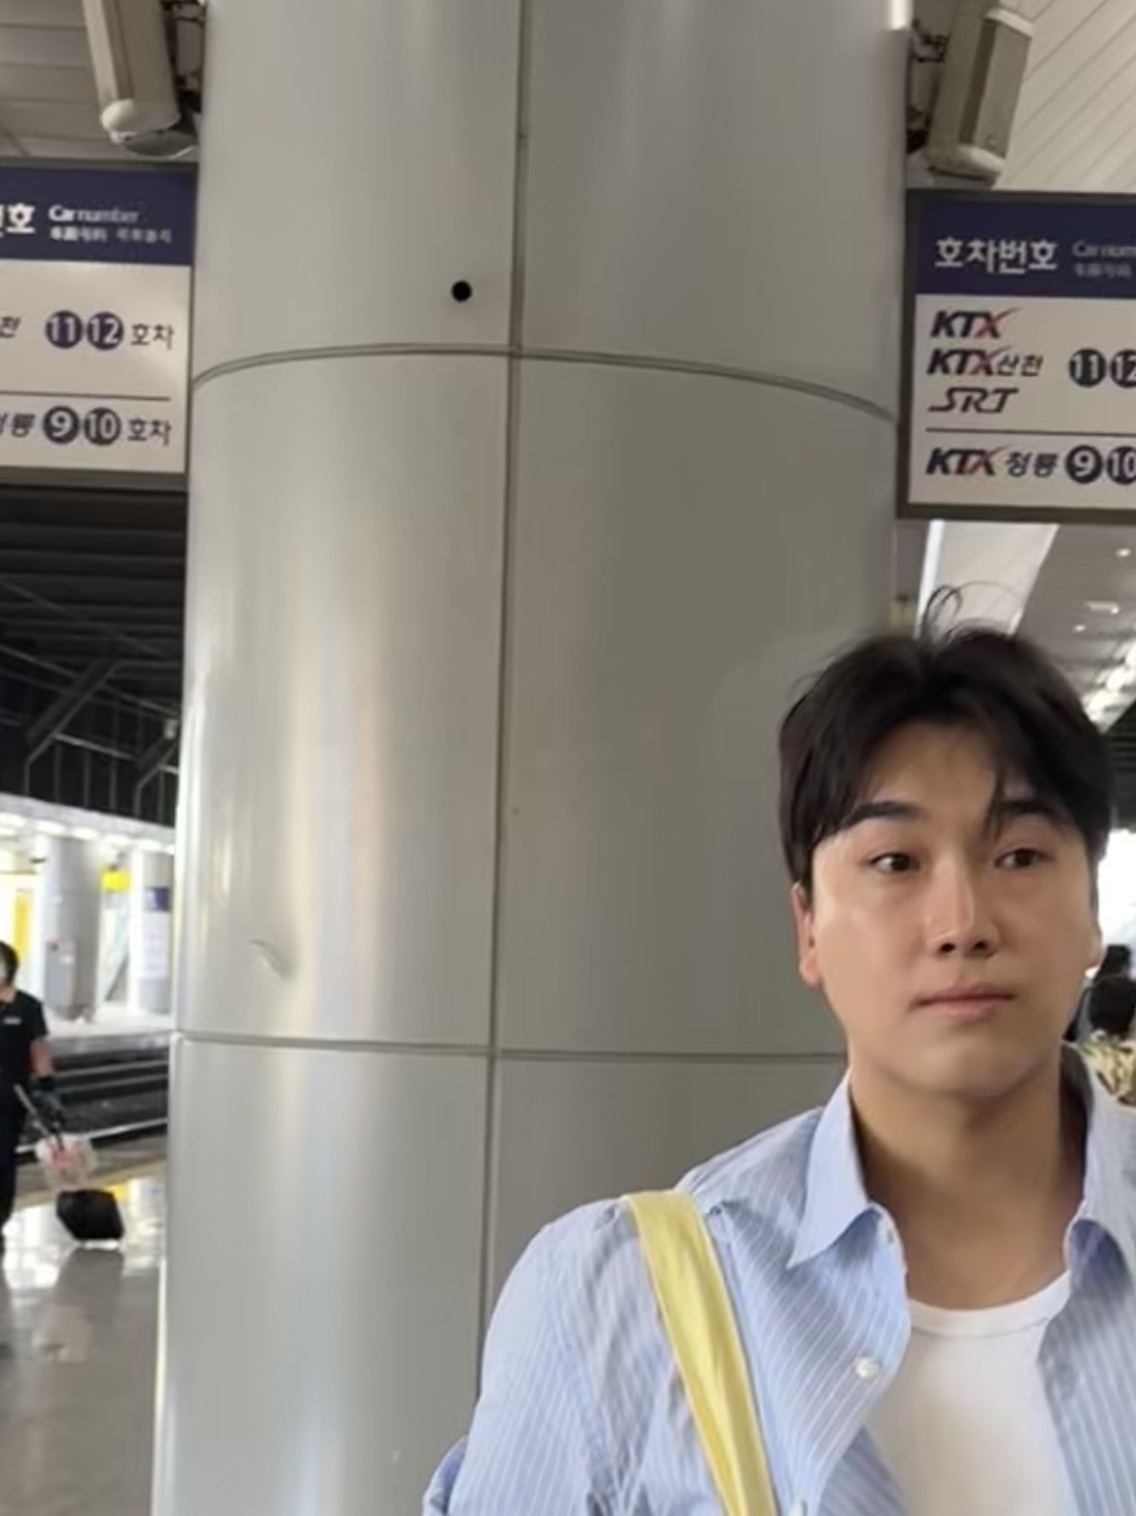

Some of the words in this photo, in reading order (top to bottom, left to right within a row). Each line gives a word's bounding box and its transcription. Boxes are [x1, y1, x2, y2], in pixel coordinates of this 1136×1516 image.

[48, 205, 76, 222] Car
[934, 236, 1058, 275] 호차번호
[1072, 240, 1099, 258] Car
[930, 307, 1021, 339] KTX
[131, 325, 175, 351] 호차
[928, 386, 1019, 413] SRT
[127, 418, 171, 446] 호차
